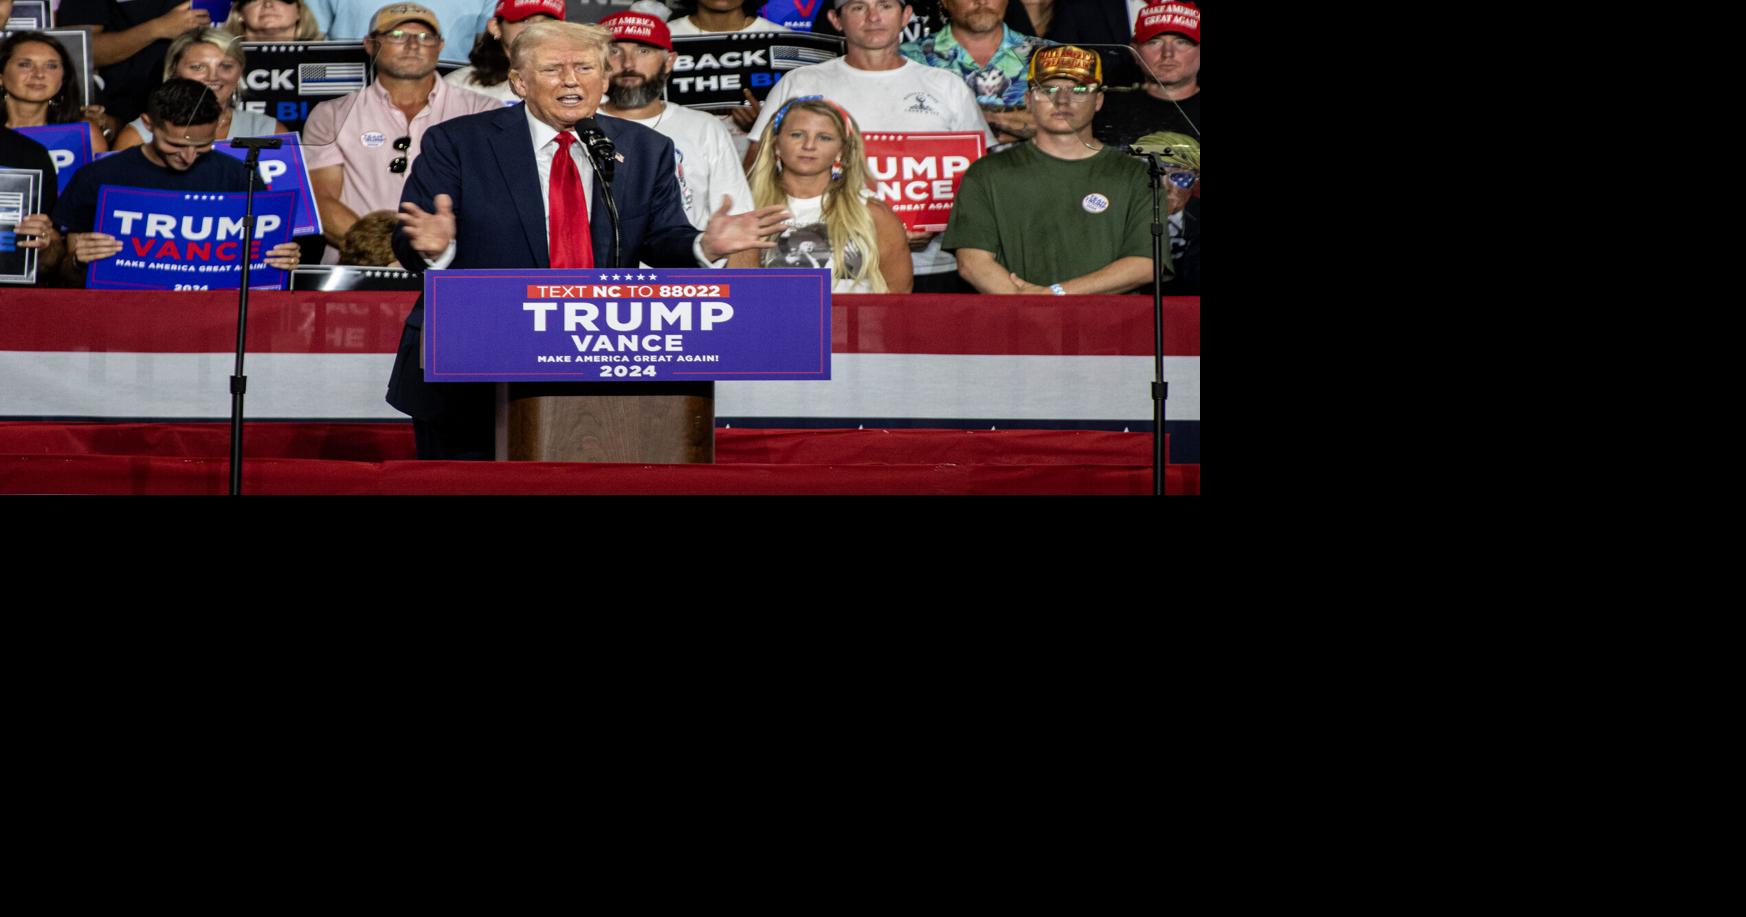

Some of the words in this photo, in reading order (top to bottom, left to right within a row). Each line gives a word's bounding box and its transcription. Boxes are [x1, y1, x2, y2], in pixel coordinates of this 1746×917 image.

[1144, 15, 1172, 27] GREAT
[1173, 15, 1198, 29] AGAIN
[672, 50, 767, 72] BACK
[672, 74, 742, 93] THE
[867, 156, 970, 180] UMP
[876, 180, 954, 201] NCE
[892, 203, 926, 212] GREAT
[113, 210, 281, 241] TRUMP
[132, 237, 262, 261] VANCE
[116, 259, 145, 268] MAKE
[148, 262, 195, 272] AMERICA
[233, 263, 267, 272] AAIN!
[537, 286, 586, 298] TEXT
[593, 286, 621, 298] NC
[626, 286, 653, 298] TO
[659, 285, 720, 298] 88022
[523, 302, 734, 331] TRUMP
[571, 335, 683, 351] VANCE
[537, 355, 571, 363] MAKE
[600, 365, 657, 377] 2024
